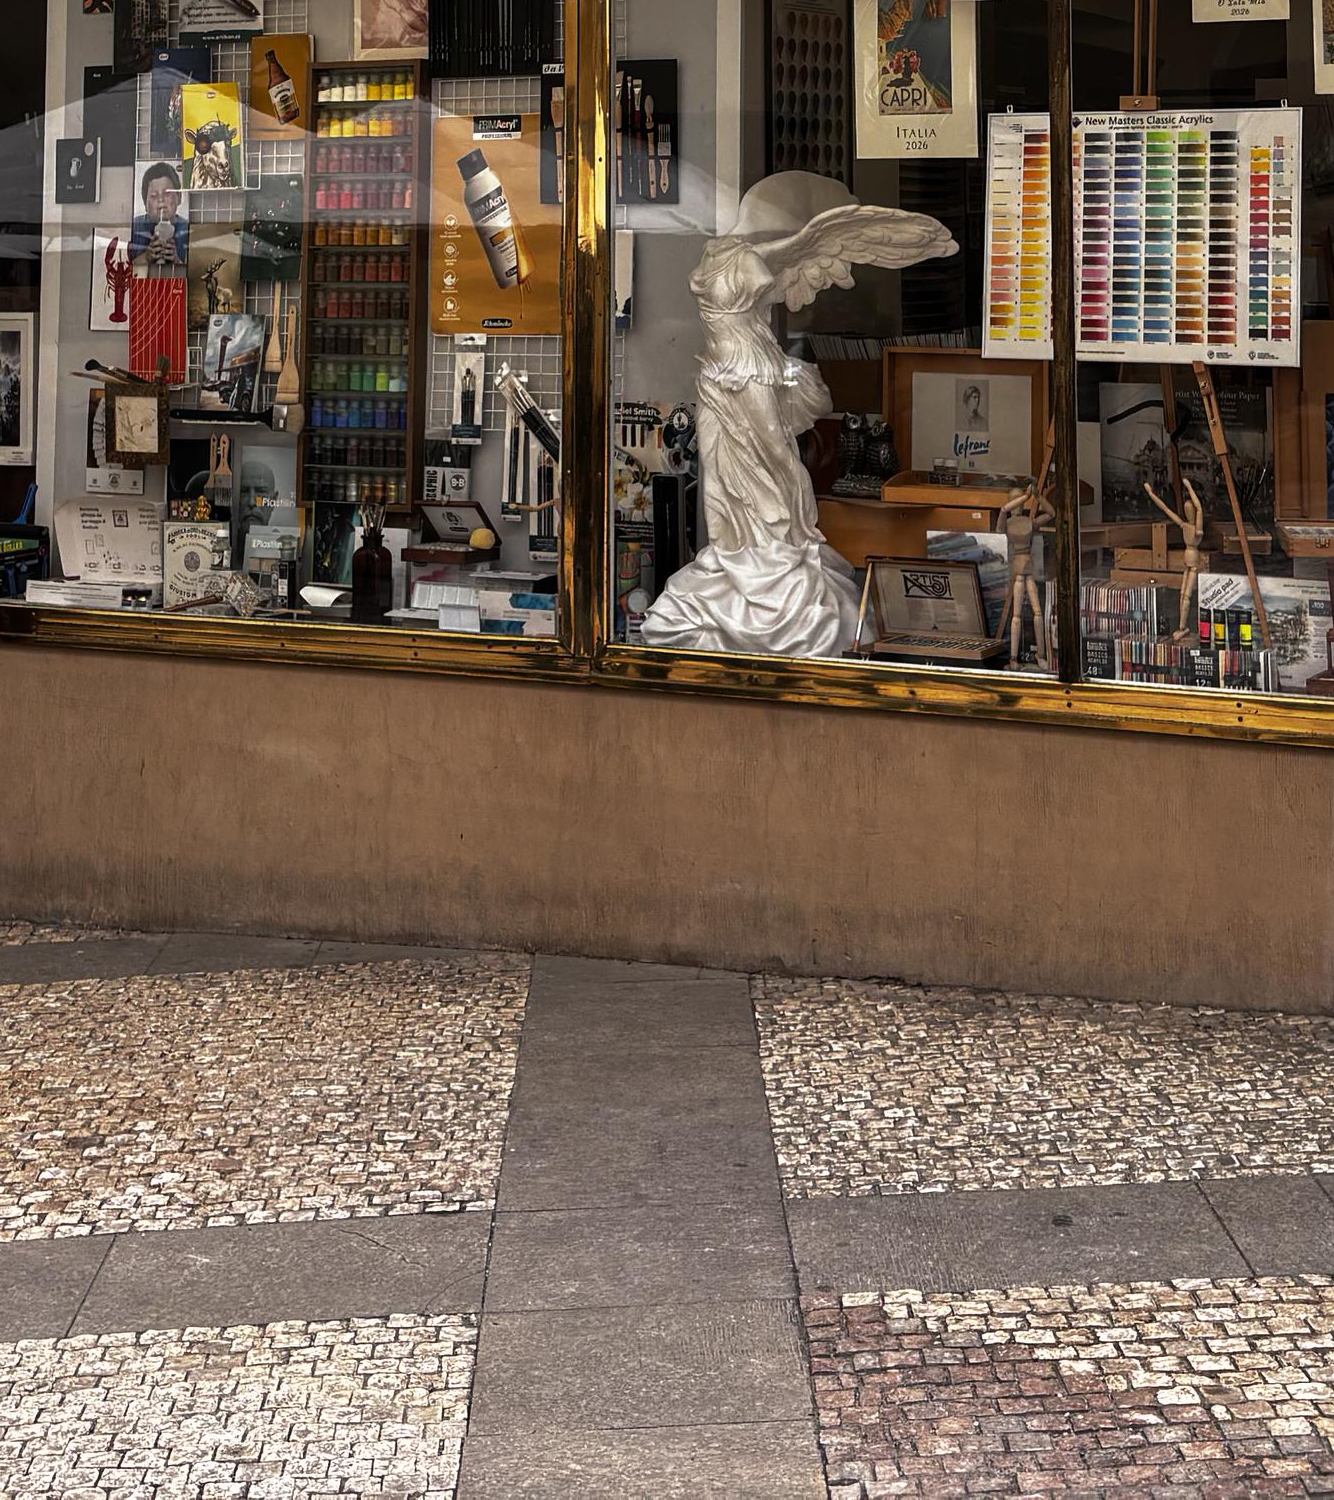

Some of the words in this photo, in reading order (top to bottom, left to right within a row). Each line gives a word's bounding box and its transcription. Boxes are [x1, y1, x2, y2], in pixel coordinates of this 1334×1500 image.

[880, 87, 927, 108] CAPRI
[1086, 117, 1107, 126] New
[1108, 116, 1145, 125] Masters
[1146, 115, 1176, 124] Classic
[1178, 114, 1214, 126] Acrylics
[905, 141, 929, 151] 2026
[634, 407, 658, 417] Smith
